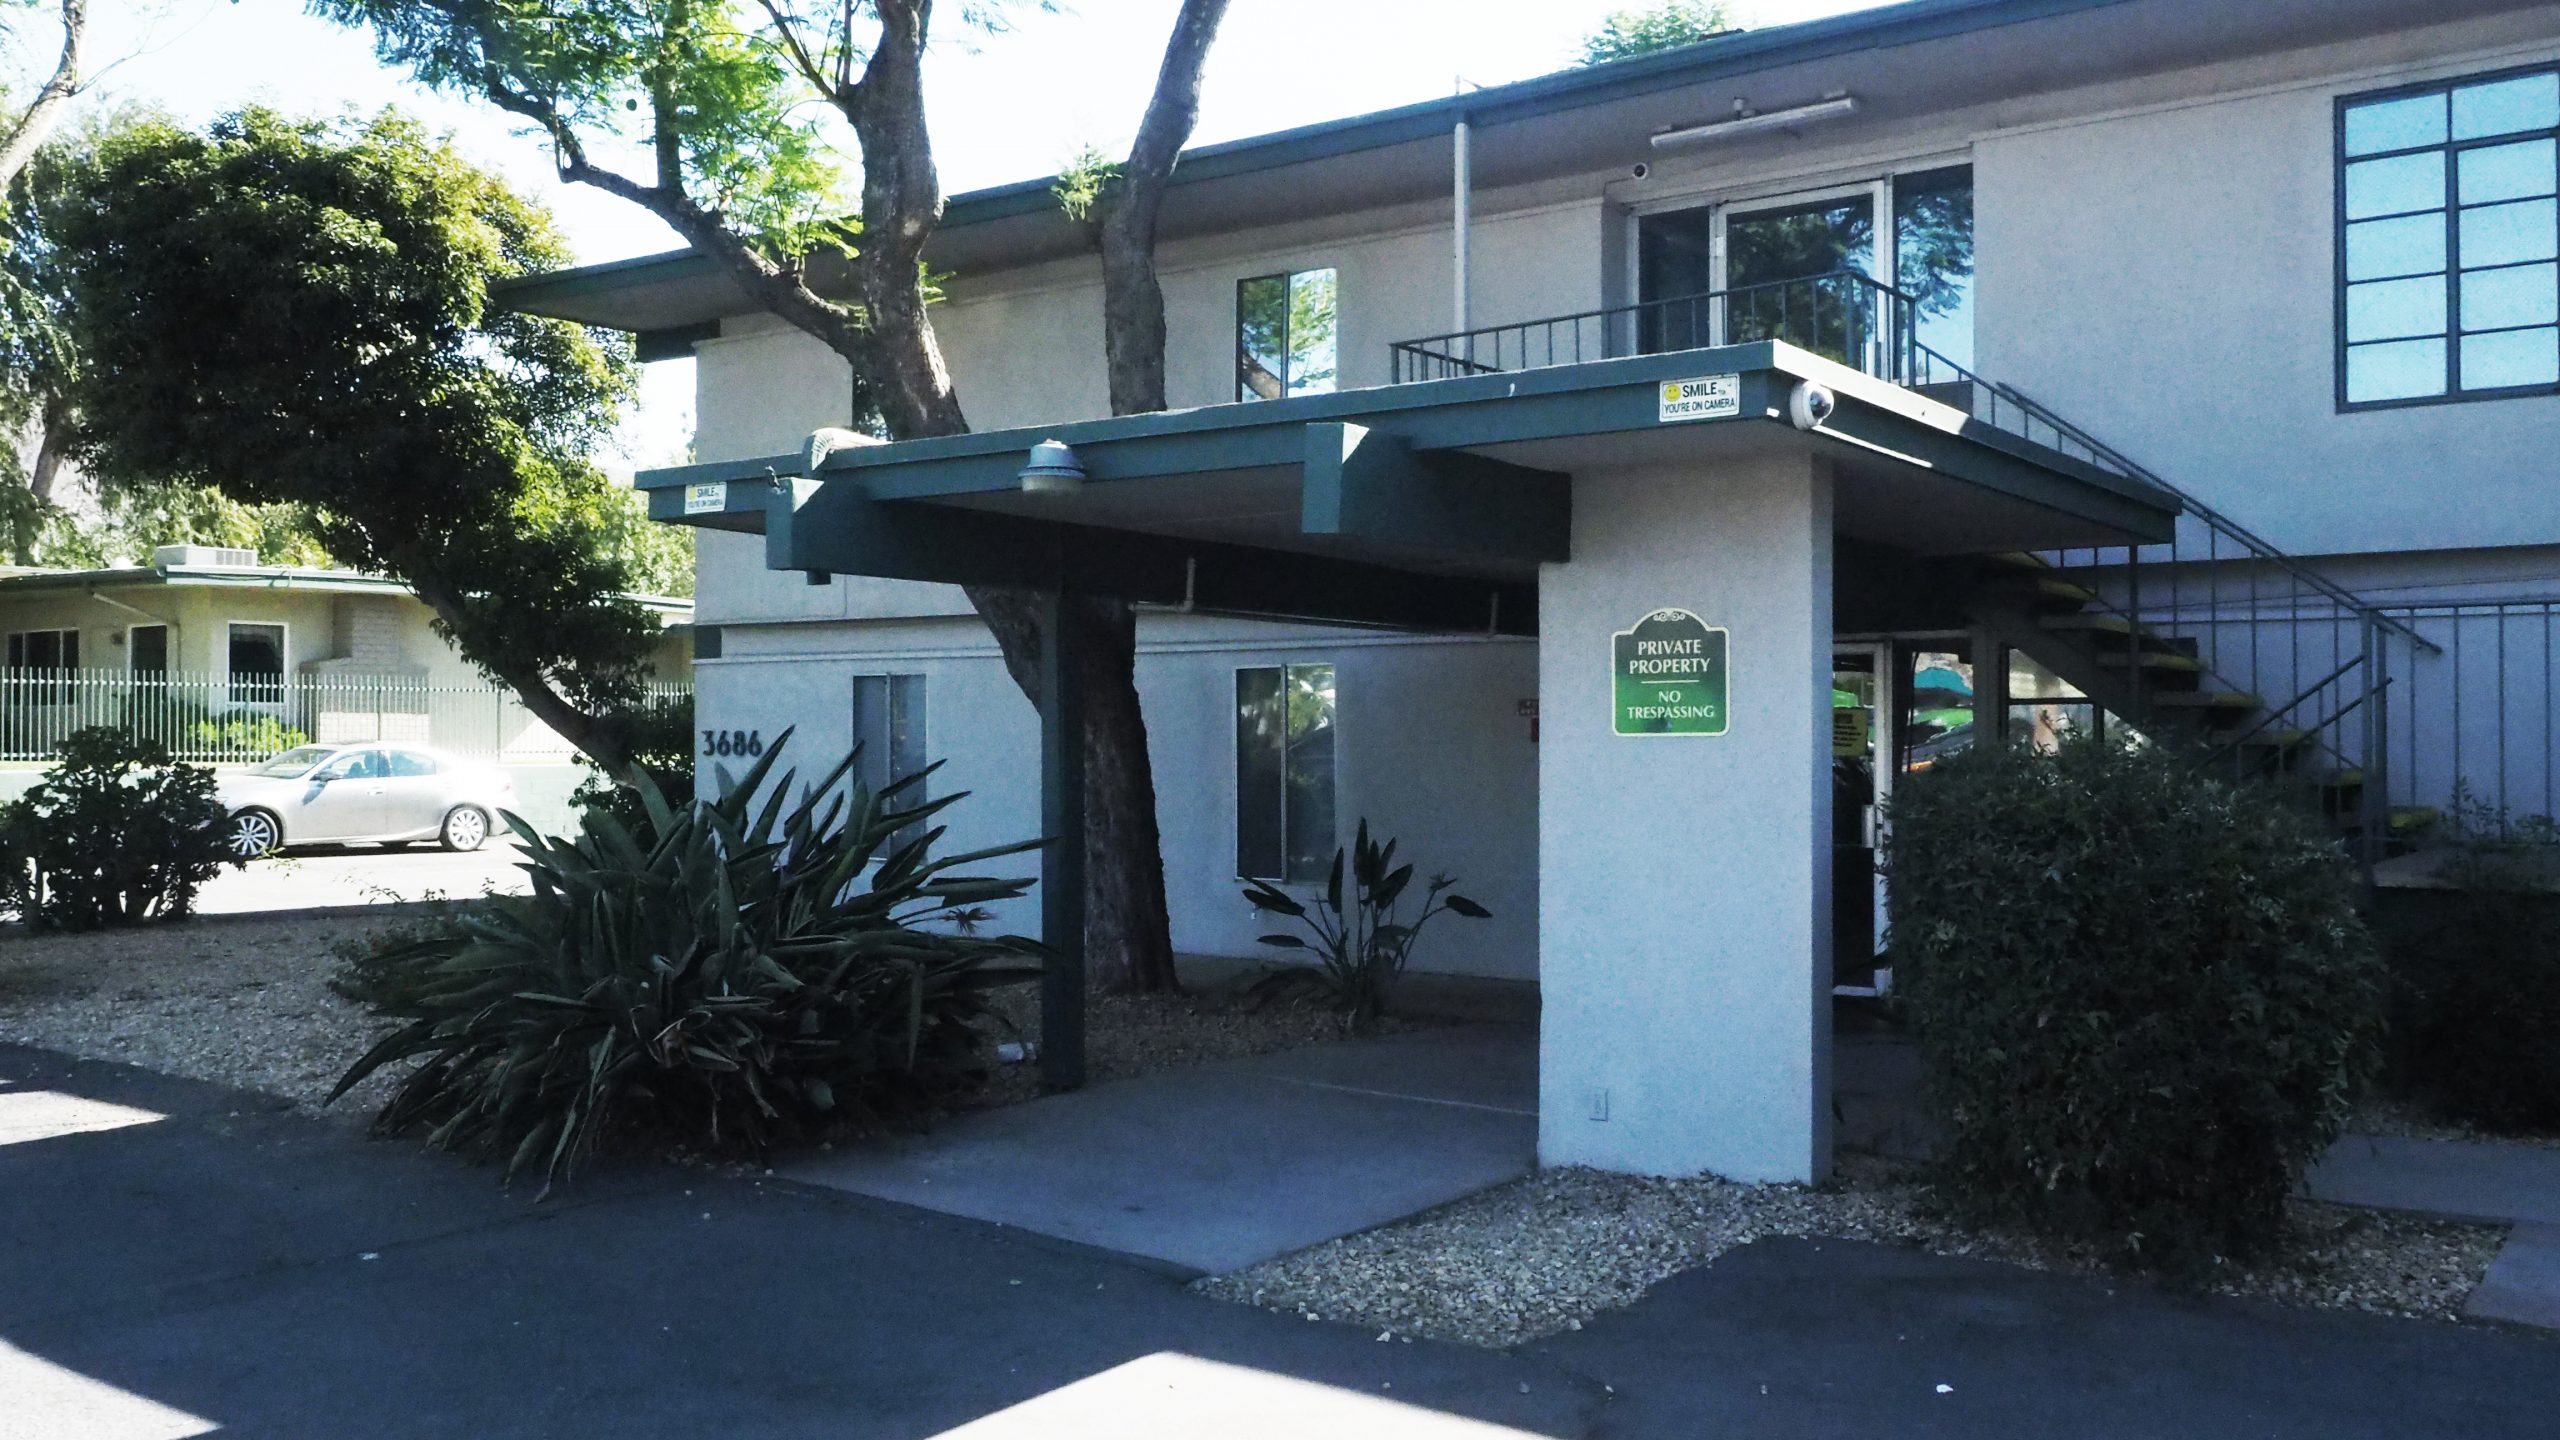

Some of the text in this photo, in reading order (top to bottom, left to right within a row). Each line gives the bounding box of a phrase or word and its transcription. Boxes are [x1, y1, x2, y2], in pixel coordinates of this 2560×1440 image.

[1682, 382, 1717, 397] SMILE
[1664, 398, 1735, 414] YOU'RE ON CAMERA
[1638, 639, 1702, 655] PRIVATE
[1629, 658, 1711, 674] PROPERTY
[1658, 690, 1681, 703] NO
[1627, 705, 1715, 719] TRESPASSING
[701, 730, 763, 757] 3686
